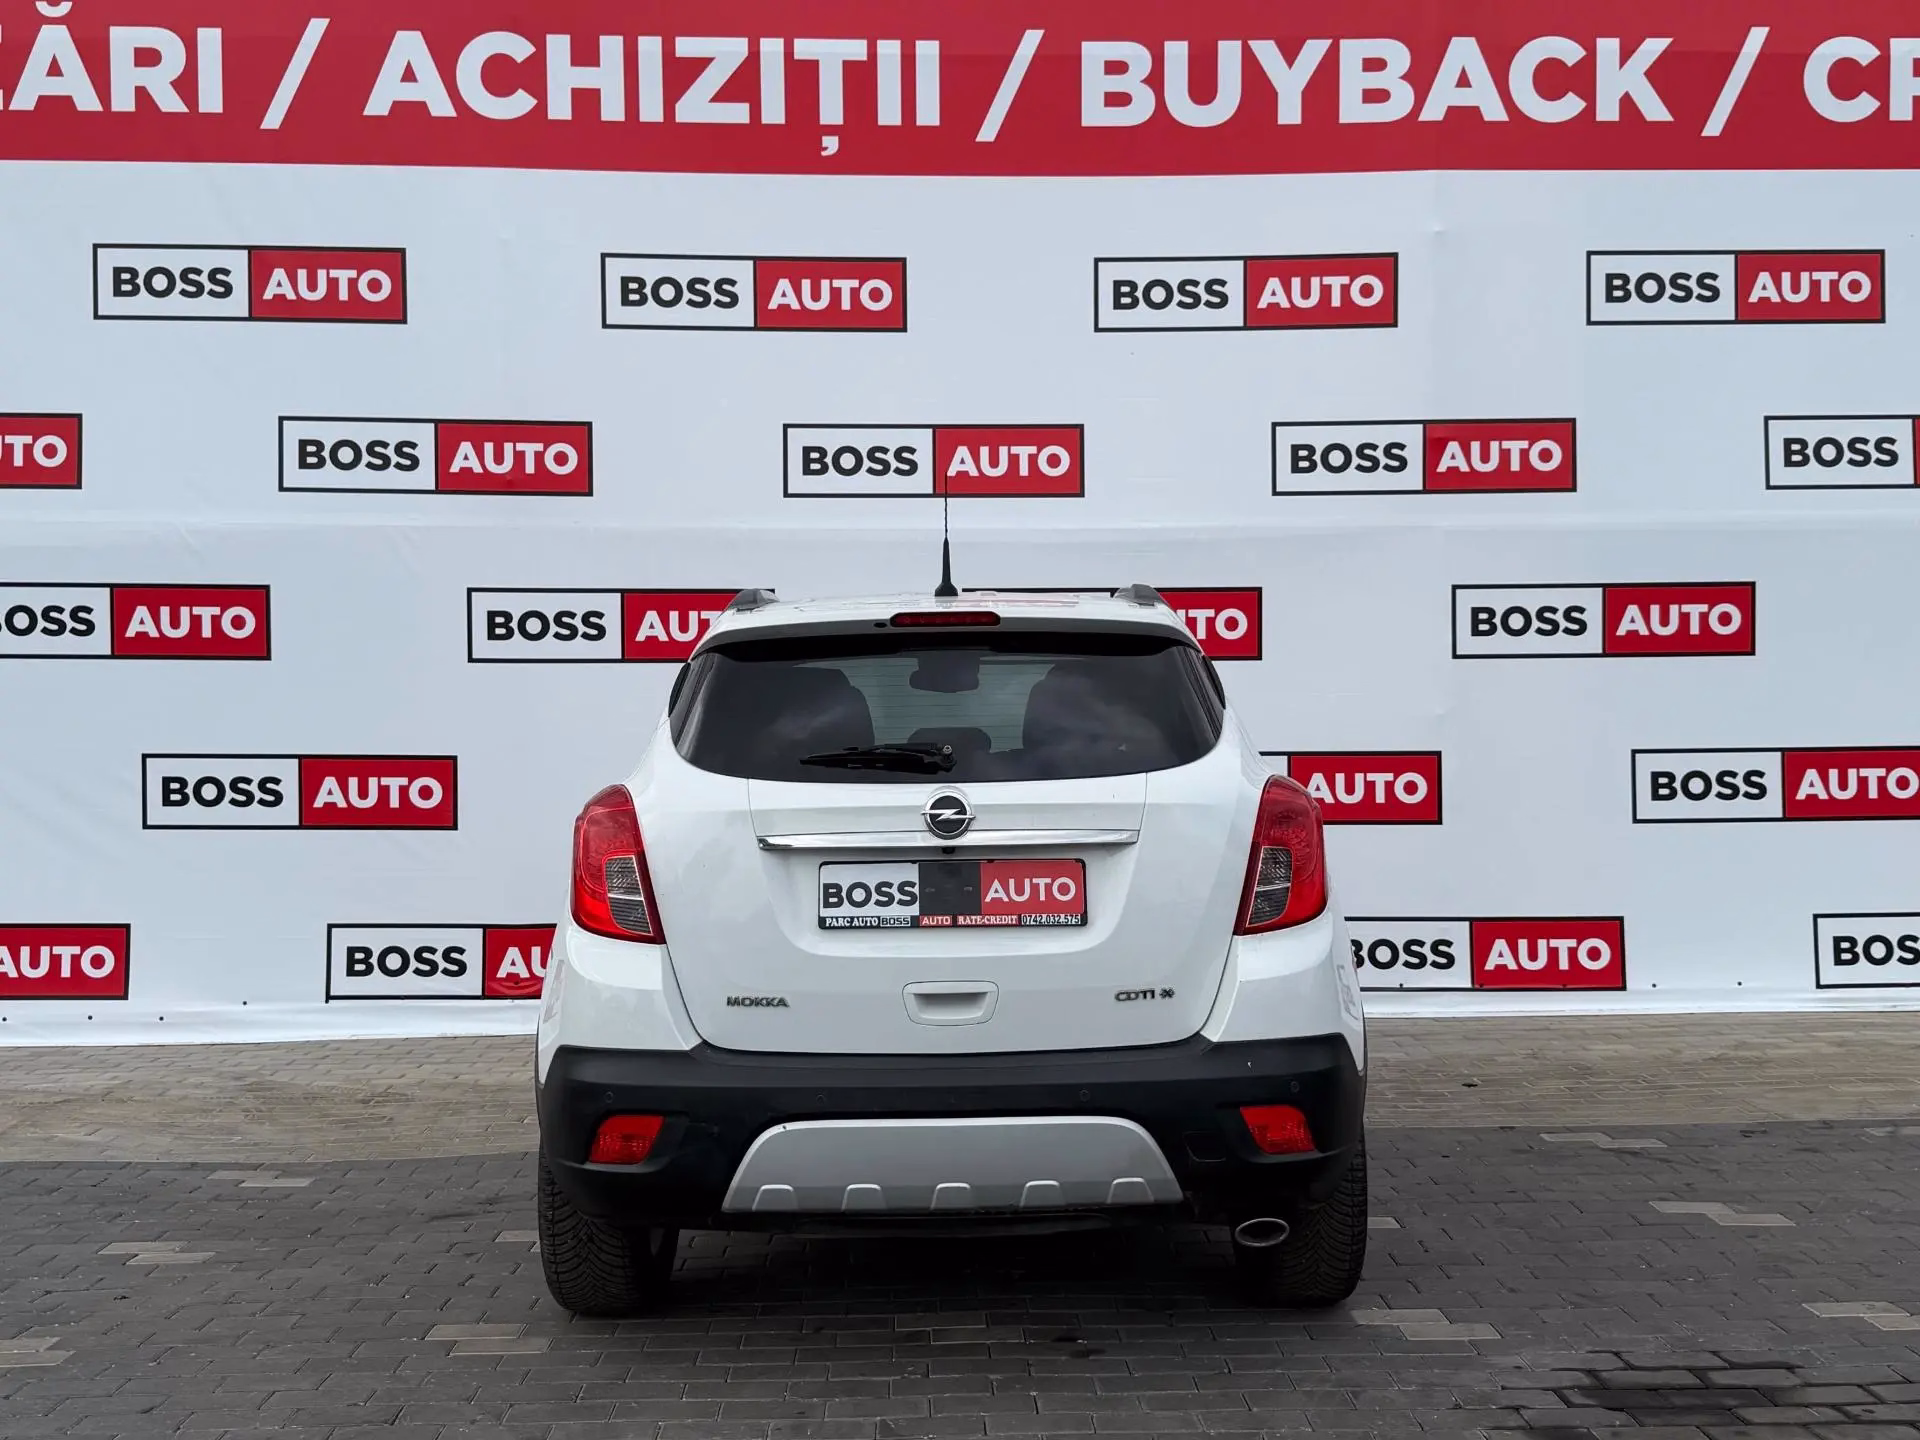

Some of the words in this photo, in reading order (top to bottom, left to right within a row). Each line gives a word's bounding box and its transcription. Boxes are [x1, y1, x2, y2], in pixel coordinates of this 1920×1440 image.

[0, 0, 224, 114] ĂRI
[260, 18, 330, 129] /
[363, 30, 940, 156] ACHIZIȚII
[976, 30, 1044, 142] /
[1082, 36, 1674, 126] BUYBACK
[1701, 27, 1769, 136] /
[113, 267, 233, 298] BOSS
[263, 268, 391, 302] AUTO
[621, 276, 739, 308] BOSS
[768, 279, 892, 311] AUTO
[1113, 279, 1228, 310] BOSS
[1257, 275, 1383, 308] AUTO
[1606, 272, 1720, 303] BOSS
[1749, 271, 1871, 302] AUTO
[299, 439, 419, 471] BOSS
[450, 442, 578, 474] AUTO
[803, 446, 918, 476] BOSS
[947, 446, 1070, 476] AUTO
[1291, 442, 1407, 473] BOSS
[1437, 440, 1562, 472] AUTO
[1784, 437, 1898, 467] BOSS
[0, 605, 95, 637] OSS
[126, 606, 255, 638] AUTO
[487, 610, 606, 641] BOSS
[1471, 606, 1587, 637] BOSS
[1616, 604, 1741, 635] AUTO
[162, 776, 283, 807] BOSS
[314, 777, 442, 808] AUTO
[1306, 772, 1428, 804] AUTO
[1651, 770, 1767, 801] BOSS
[1796, 768, 1919, 799] AUTO
[822, 880, 919, 908] BOSS
[984, 876, 1076, 902] AUTO
[825, 917, 851, 927] PARC
[852, 916, 879, 926] AUTO
[881, 916, 910, 926] BOSS
[921, 916, 951, 926] AUTO
[346, 946, 467, 977] BOSS
[1485, 938, 1610, 970] AUTO
[726, 995, 790, 1008] MOKKA
[1114, 987, 1156, 1002] CDTI
